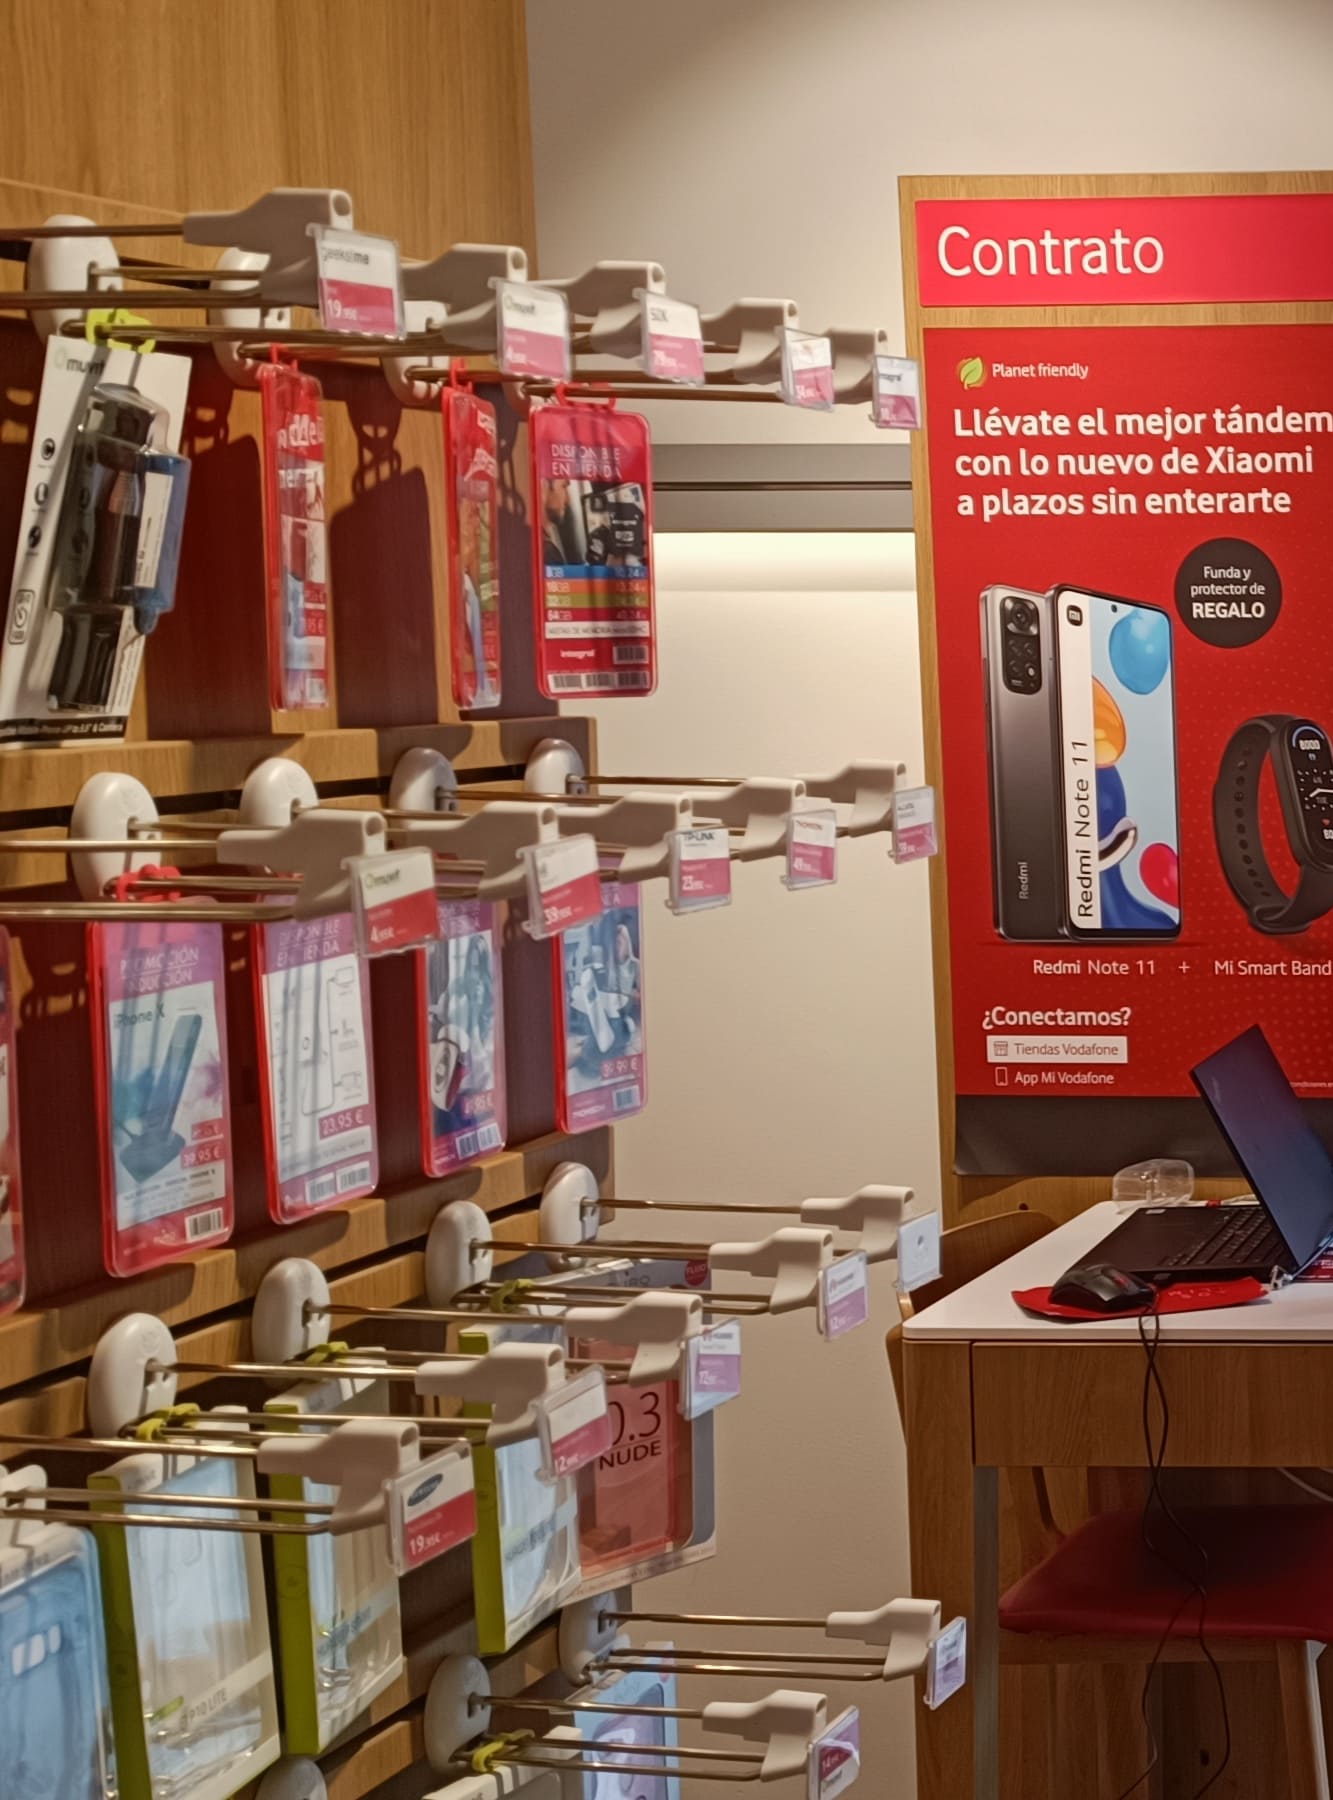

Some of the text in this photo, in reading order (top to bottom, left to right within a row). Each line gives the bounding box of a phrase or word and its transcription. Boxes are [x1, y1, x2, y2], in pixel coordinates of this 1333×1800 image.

[937, 225, 1165, 277] Contrato
[992, 360, 1089, 380] Planet friendly
[953, 404, 1333, 441] Llévate el mejor tándem
[955, 445, 1313, 477] con lo nuevo de Xiaomi
[957, 487, 1291, 521] a plazos sin enterarte
[1203, 565, 1251, 582] Funda y
[1191, 582, 1265, 598] protector de
[1192, 602, 1265, 618] REGALO
[1071, 741, 1094, 918] Redmi Note 11
[1018, 861, 1029, 900] Redmi
[1033, 959, 1081, 975] Redmi
[1088, 960, 1129, 976] Note
[1136, 960, 1155, 976] 11
[1215, 960, 1233, 975] Mi
[1238, 960, 1287, 975] Smart
[1292, 960, 1331, 975] Band
[982, 1006, 1132, 1029] ¿Conectamos?
[1014, 1042, 1119, 1056] Tiendas Vodafone
[1014, 1071, 1115, 1087] App Mi Vodafone
[600, 1439, 662, 1471] NUDE
